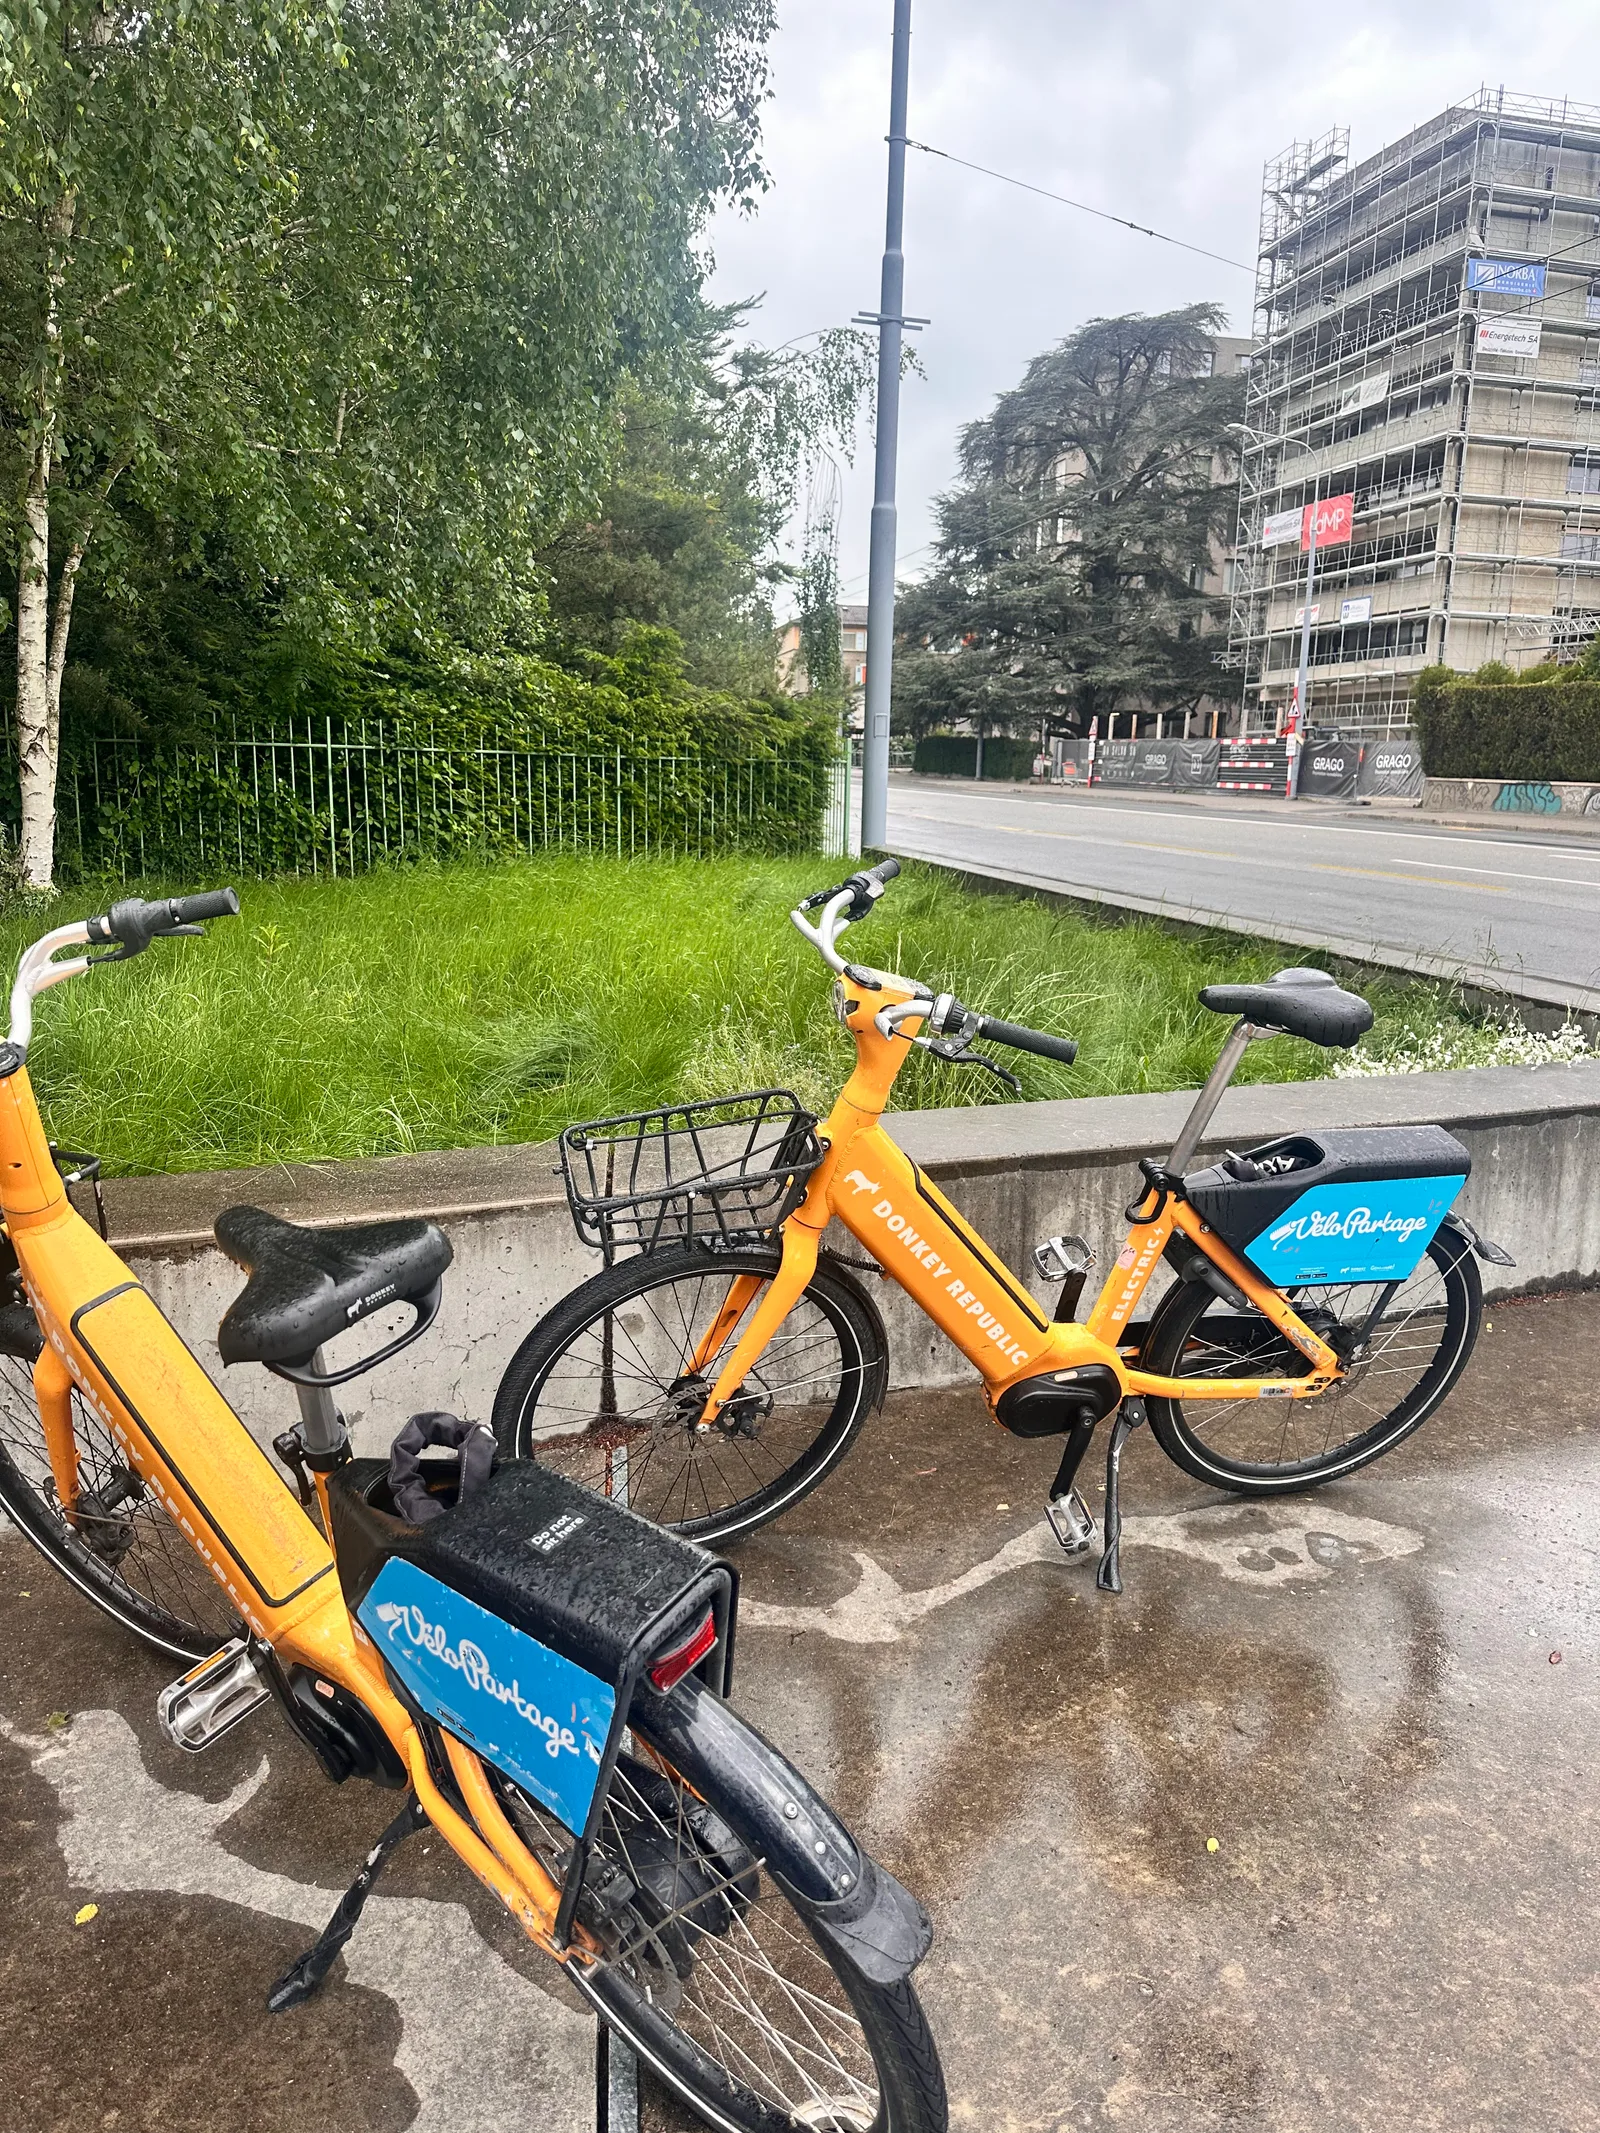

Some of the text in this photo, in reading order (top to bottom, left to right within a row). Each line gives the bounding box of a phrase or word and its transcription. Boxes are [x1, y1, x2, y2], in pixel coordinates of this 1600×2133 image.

[1497, 264, 1536, 281] NORBA
[1488, 330, 1538, 344] Energetech SA
[1313, 757, 1344, 771] GRAGO
[1376, 754, 1411, 769] GRAGO
[872, 1199, 1029, 1366] DONKEY REPUBLIC
[1111, 1238, 1160, 1321] ELECTRIC
[365, 1283, 395, 1303] DONKEY
[51, 1329, 267, 1638] DONKEY REPUBLIC
[531, 1514, 572, 1545] Do not
[541, 1517, 585, 1551] sit here
